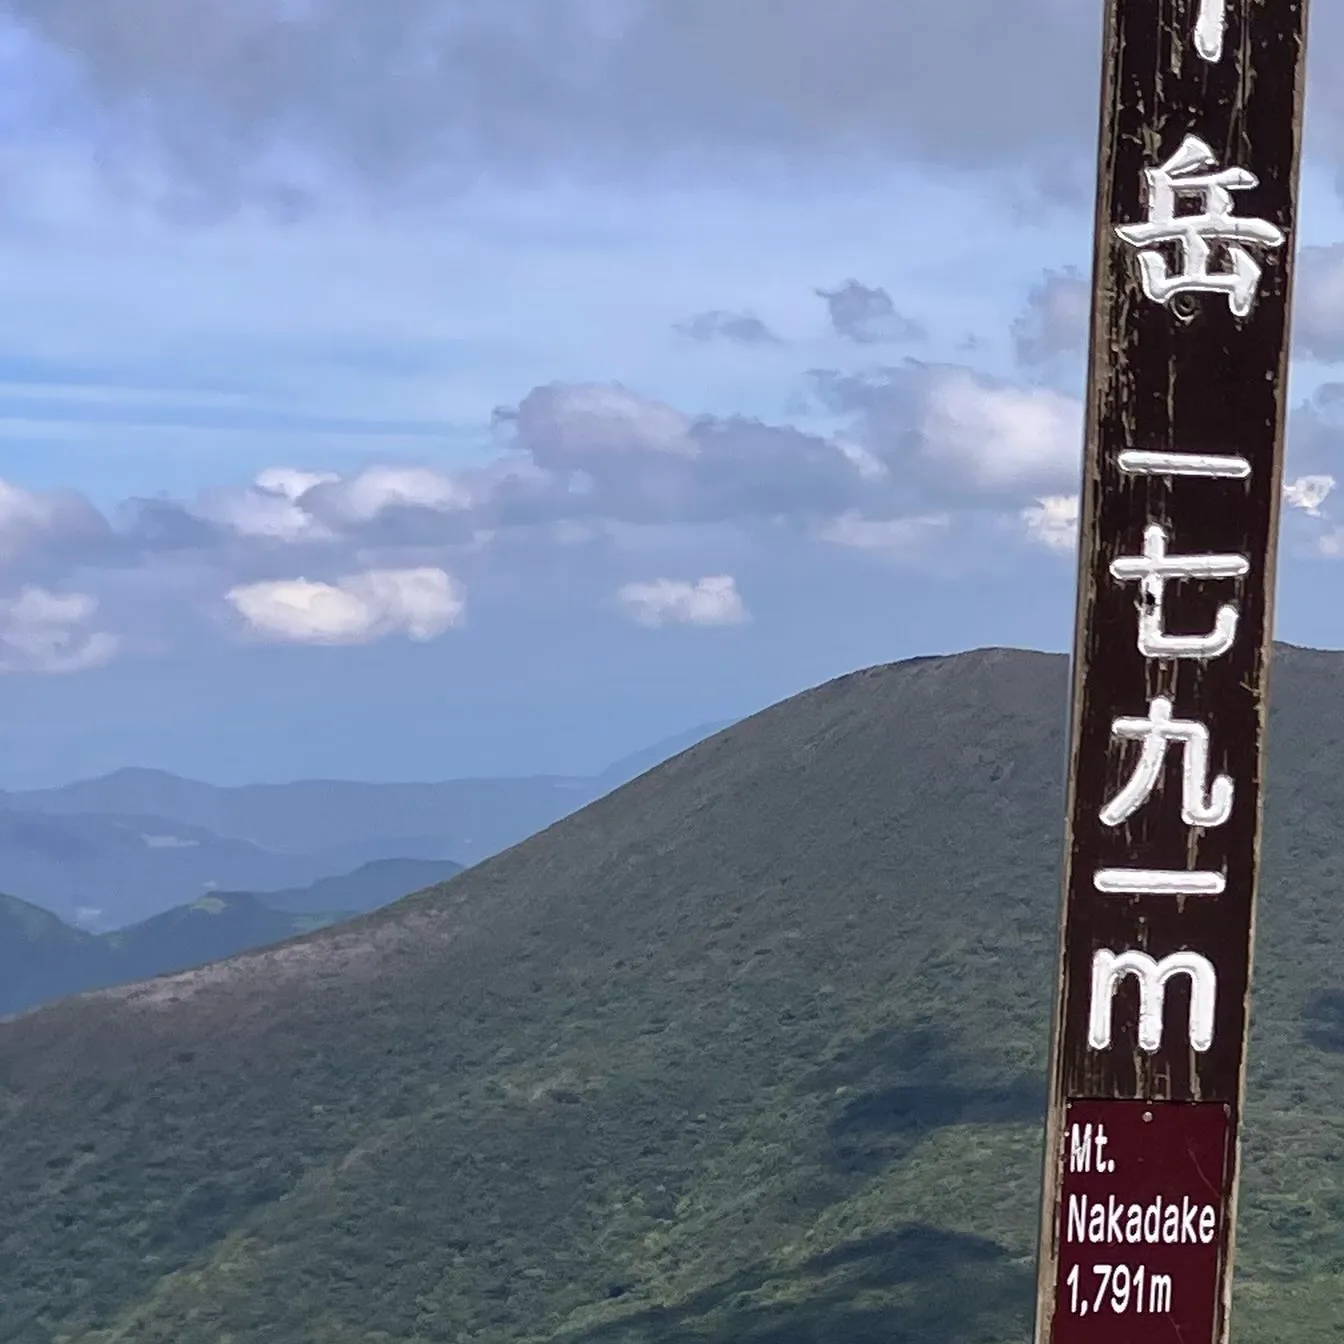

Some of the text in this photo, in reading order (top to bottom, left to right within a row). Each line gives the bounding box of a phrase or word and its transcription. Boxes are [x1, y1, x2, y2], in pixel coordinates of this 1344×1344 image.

[1089, 449, 1252, 1051] 一七九一m
[1069, 1122, 1116, 1173] Mt.
[1067, 1193, 1216, 1244] Nakadake
[1066, 1263, 1172, 1316] 1,791m
